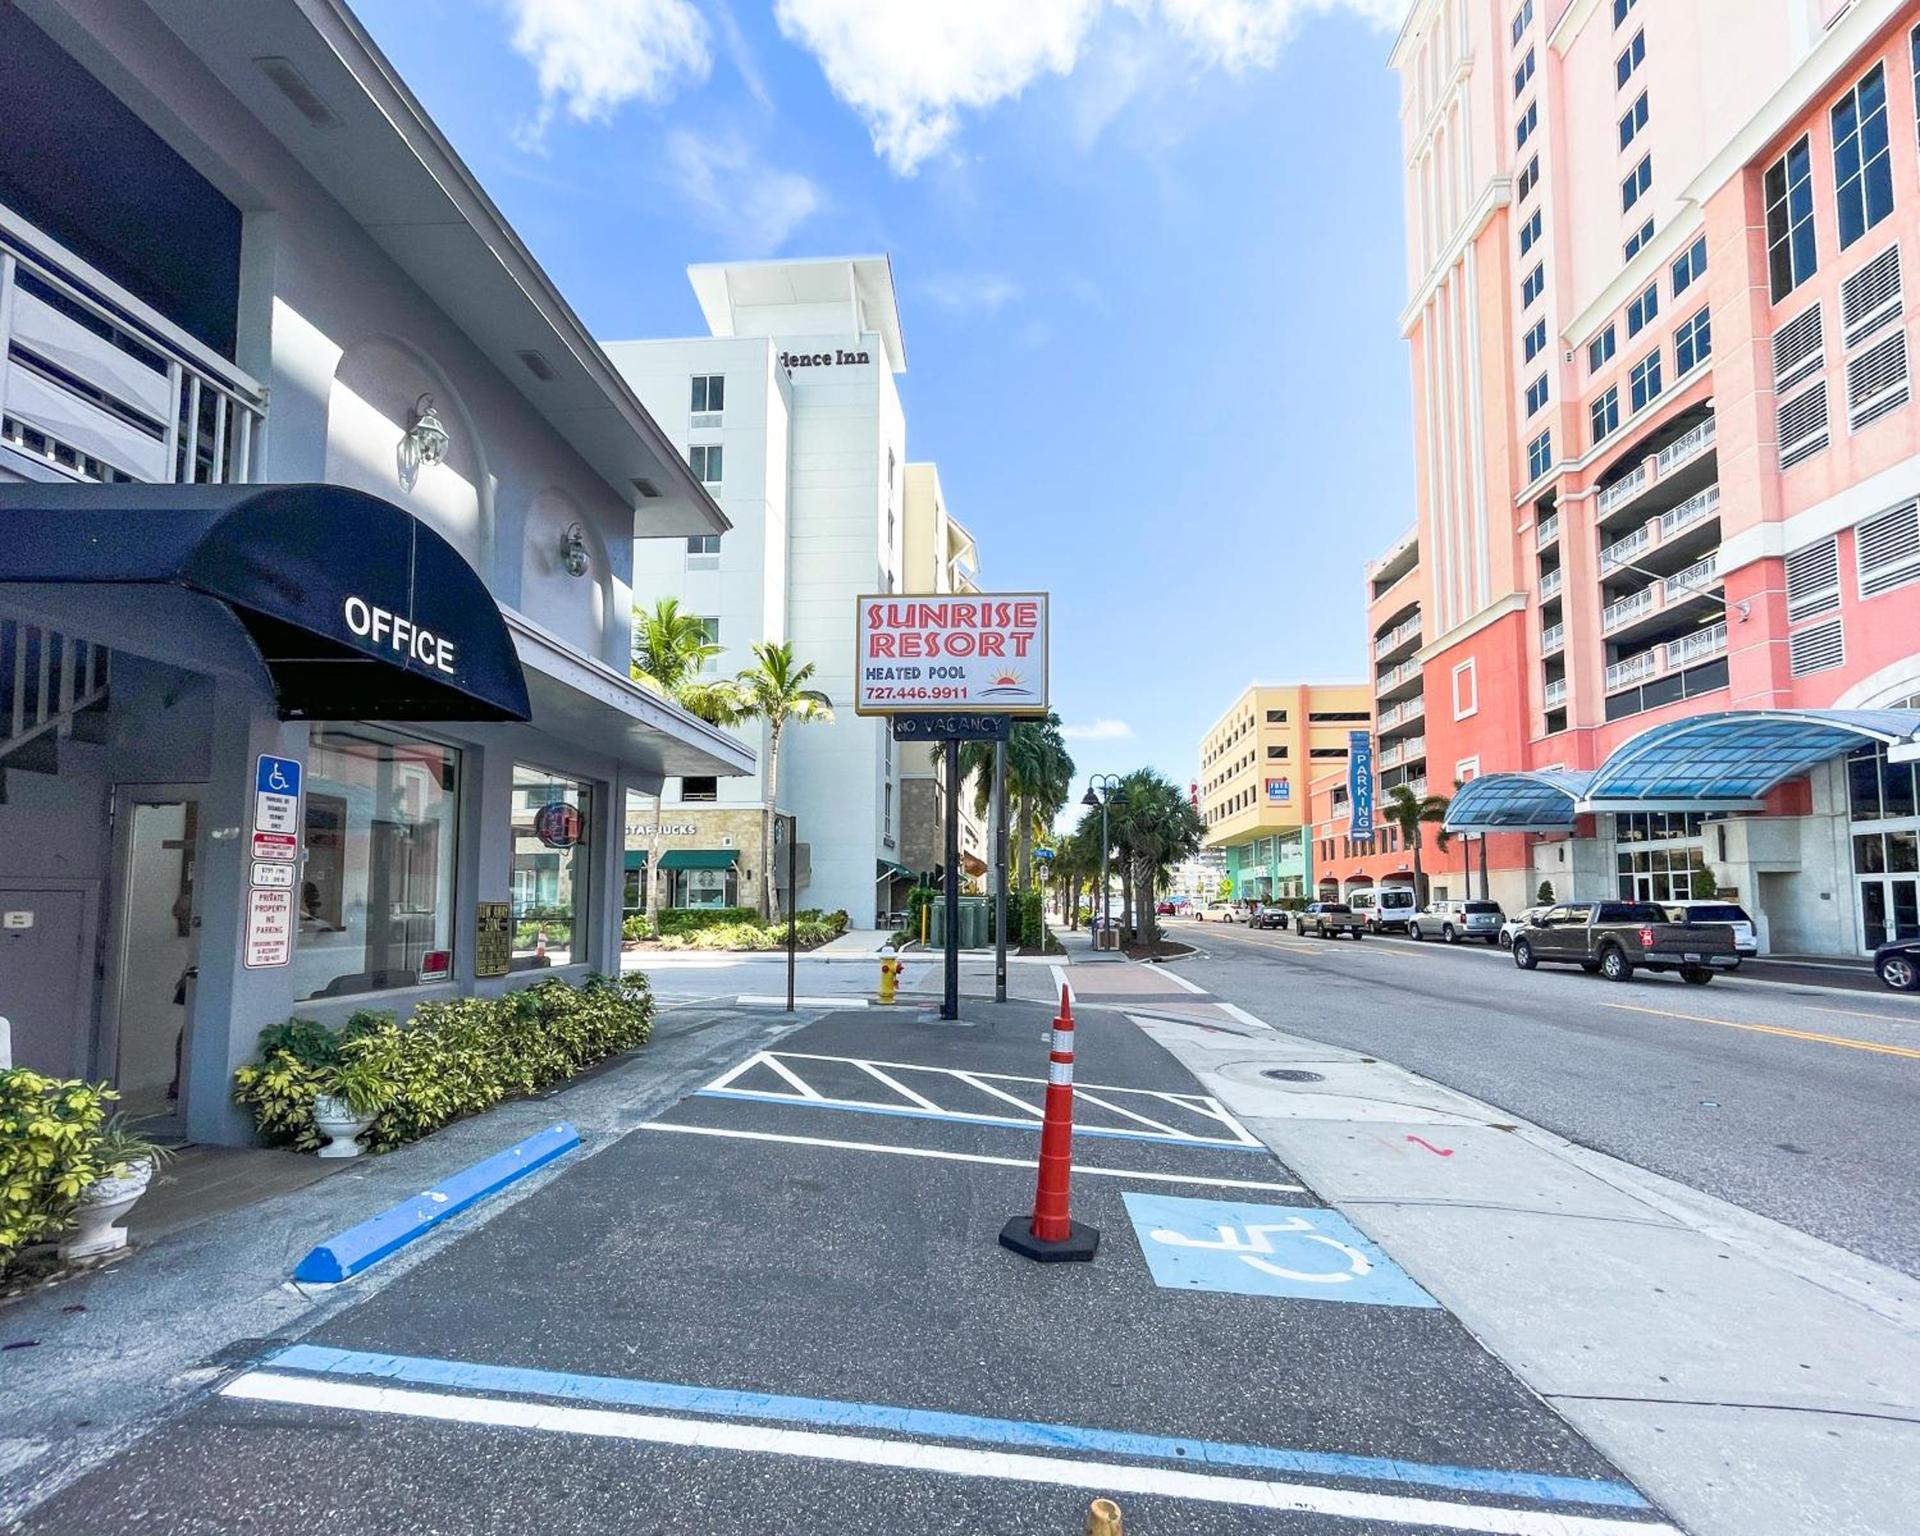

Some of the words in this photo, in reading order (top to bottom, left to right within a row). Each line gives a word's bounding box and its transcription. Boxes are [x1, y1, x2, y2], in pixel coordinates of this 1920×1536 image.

[836, 350, 870, 365] Inn
[867, 602, 1038, 629] SUNRISE
[345, 596, 454, 674] OFFICE
[869, 632, 1035, 658] RESORT
[866, 667, 921, 681] HEATED
[928, 666, 967, 680] POOL
[866, 686, 968, 700] 727.446.9911
[896, 719, 916, 733] NO
[923, 717, 1001, 733] VACANCY
[1356, 754, 1369, 827] PARKING
[259, 893, 284, 902] PRIVATE
[255, 904, 287, 913] PROPERTY
[265, 915, 275, 923] NO
[256, 926, 283, 934] PARKING
